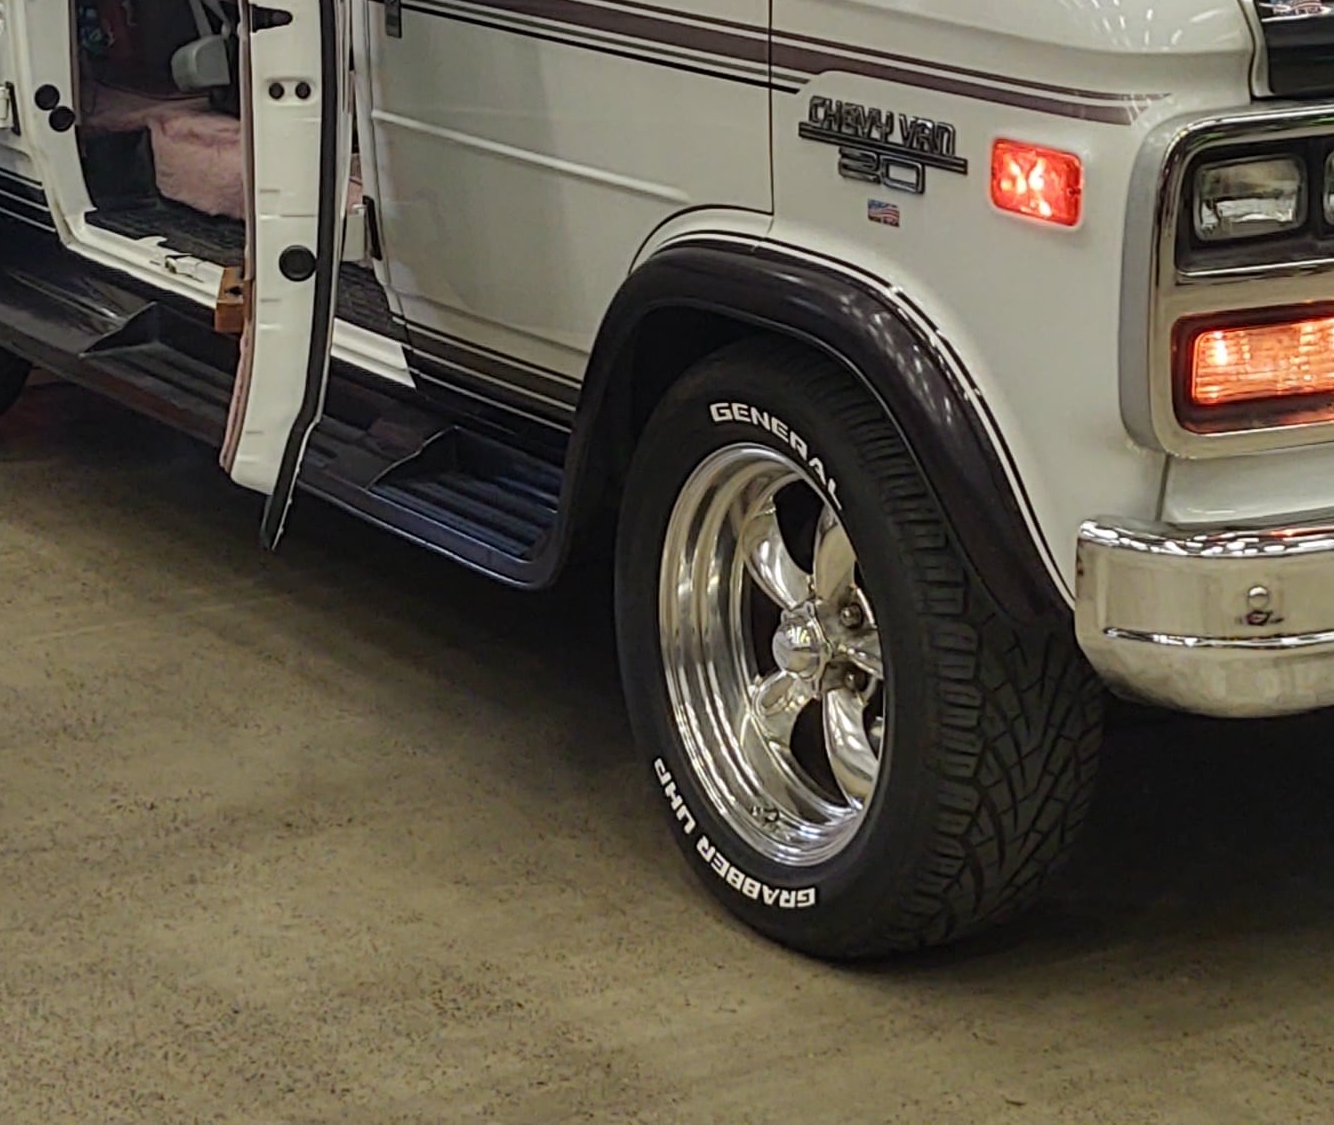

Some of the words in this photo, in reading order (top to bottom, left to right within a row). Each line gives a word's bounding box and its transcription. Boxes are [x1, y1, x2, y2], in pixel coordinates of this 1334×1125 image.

[809, 95, 894, 143] CHEVY
[899, 113, 956, 157] VAN
[838, 146, 926, 195] 20
[709, 402, 842, 511] GENERAL
[653, 757, 696, 835] UHP
[695, 835, 816, 909] GRABBER
